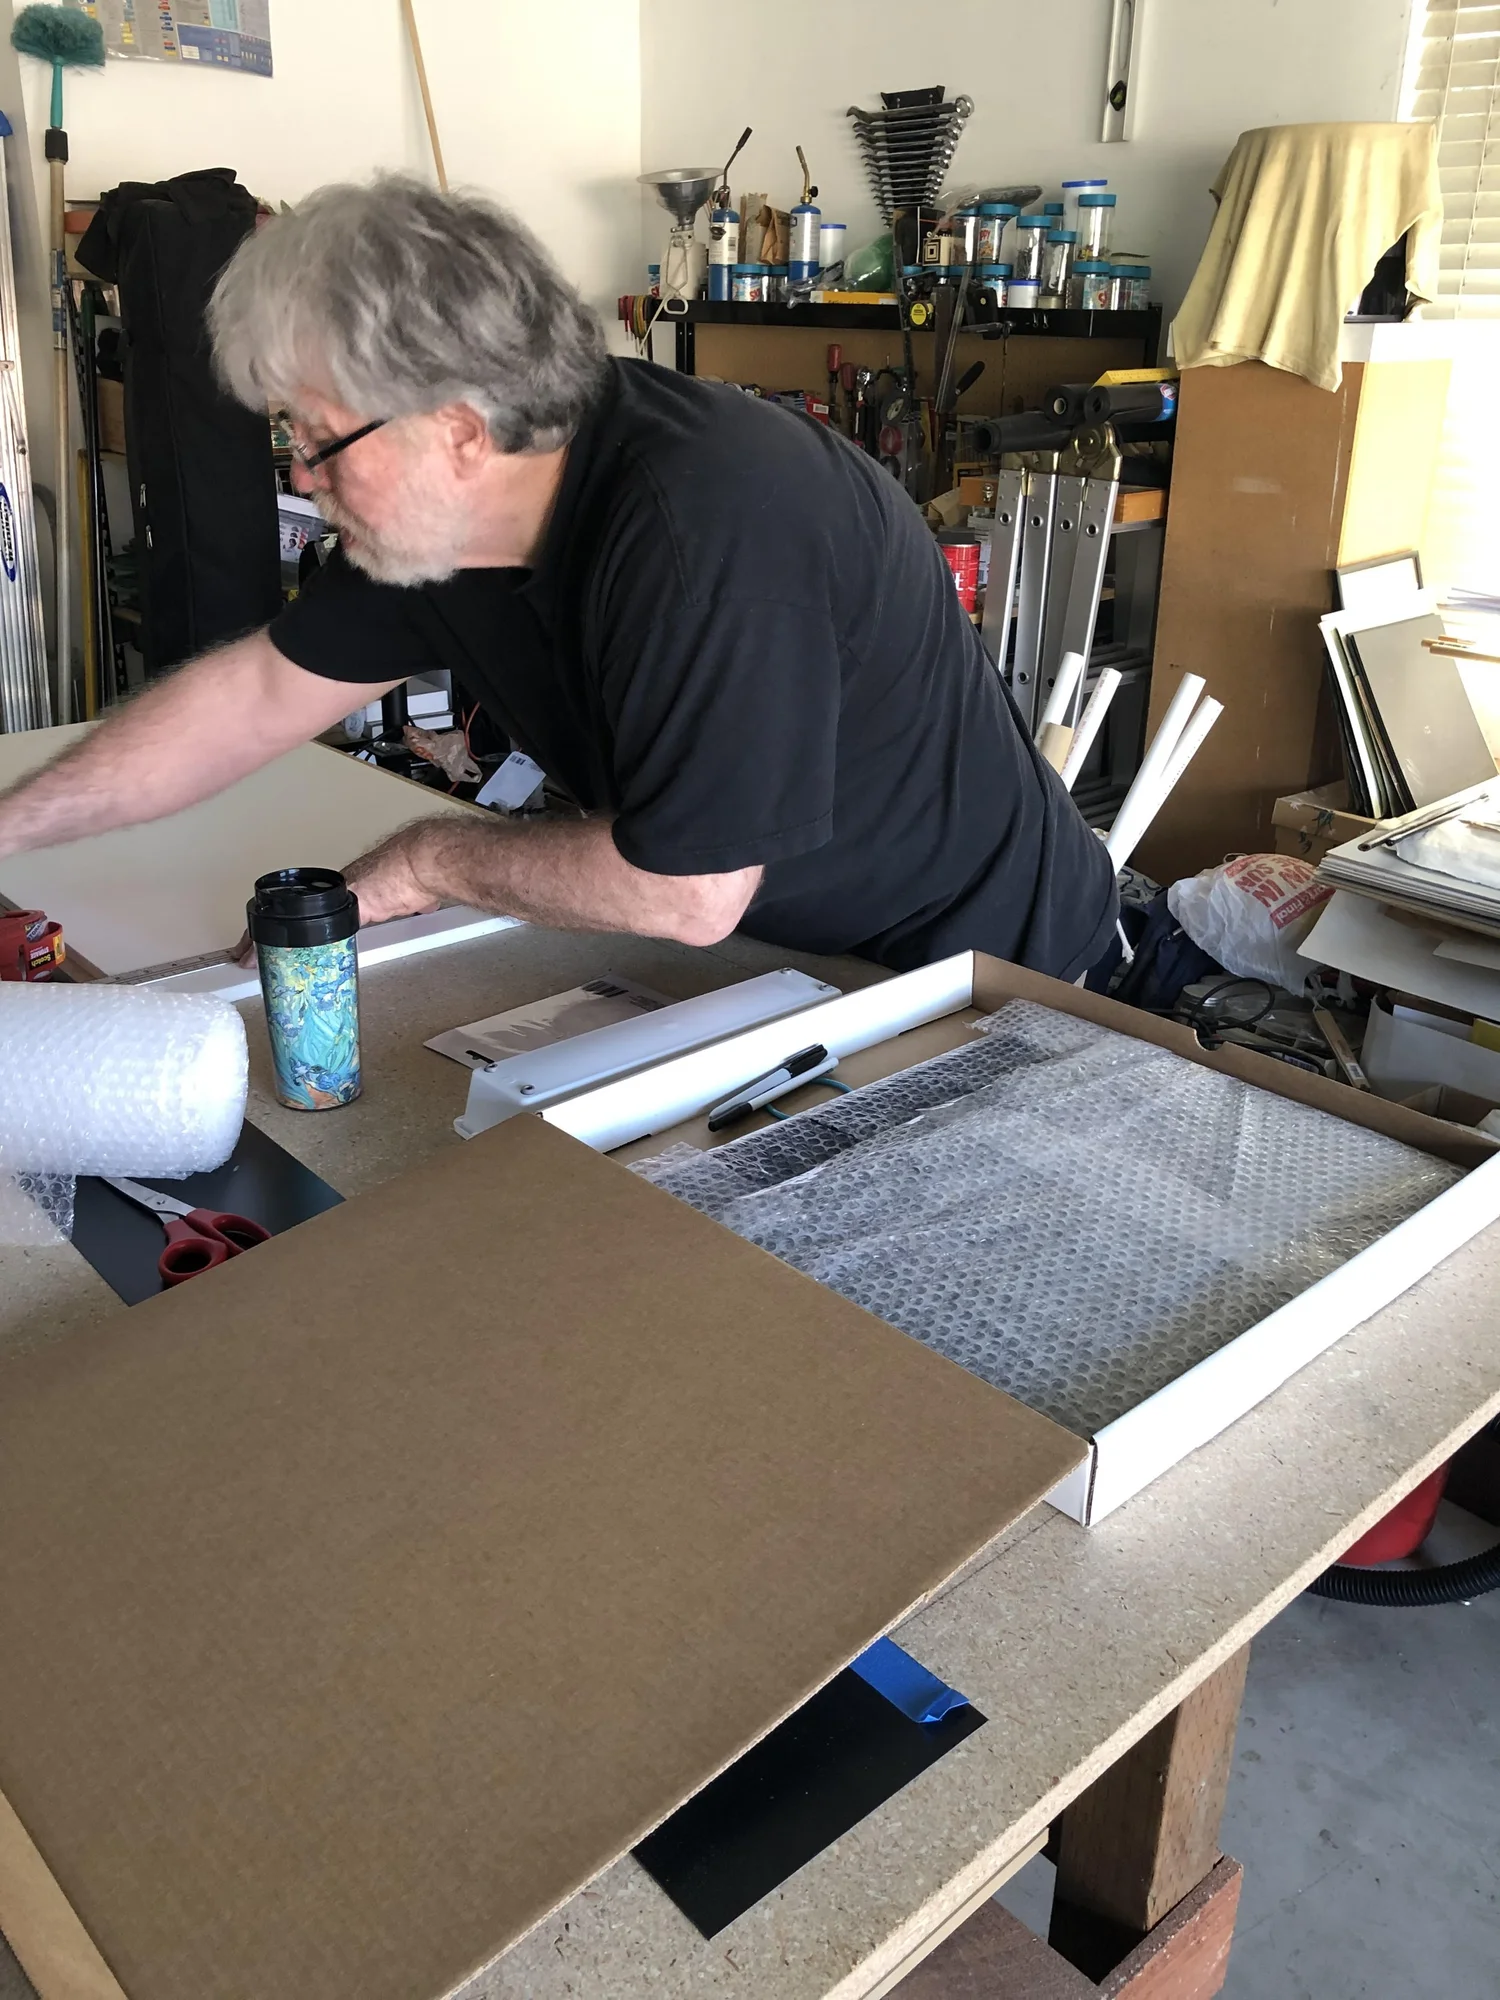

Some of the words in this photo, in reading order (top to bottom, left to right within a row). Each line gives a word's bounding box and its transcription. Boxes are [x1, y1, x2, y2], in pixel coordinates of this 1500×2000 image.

[1235, 863, 1274, 893] SUN
[1252, 879, 1285, 907] IN
[31, 953, 51, 968] Scotch
